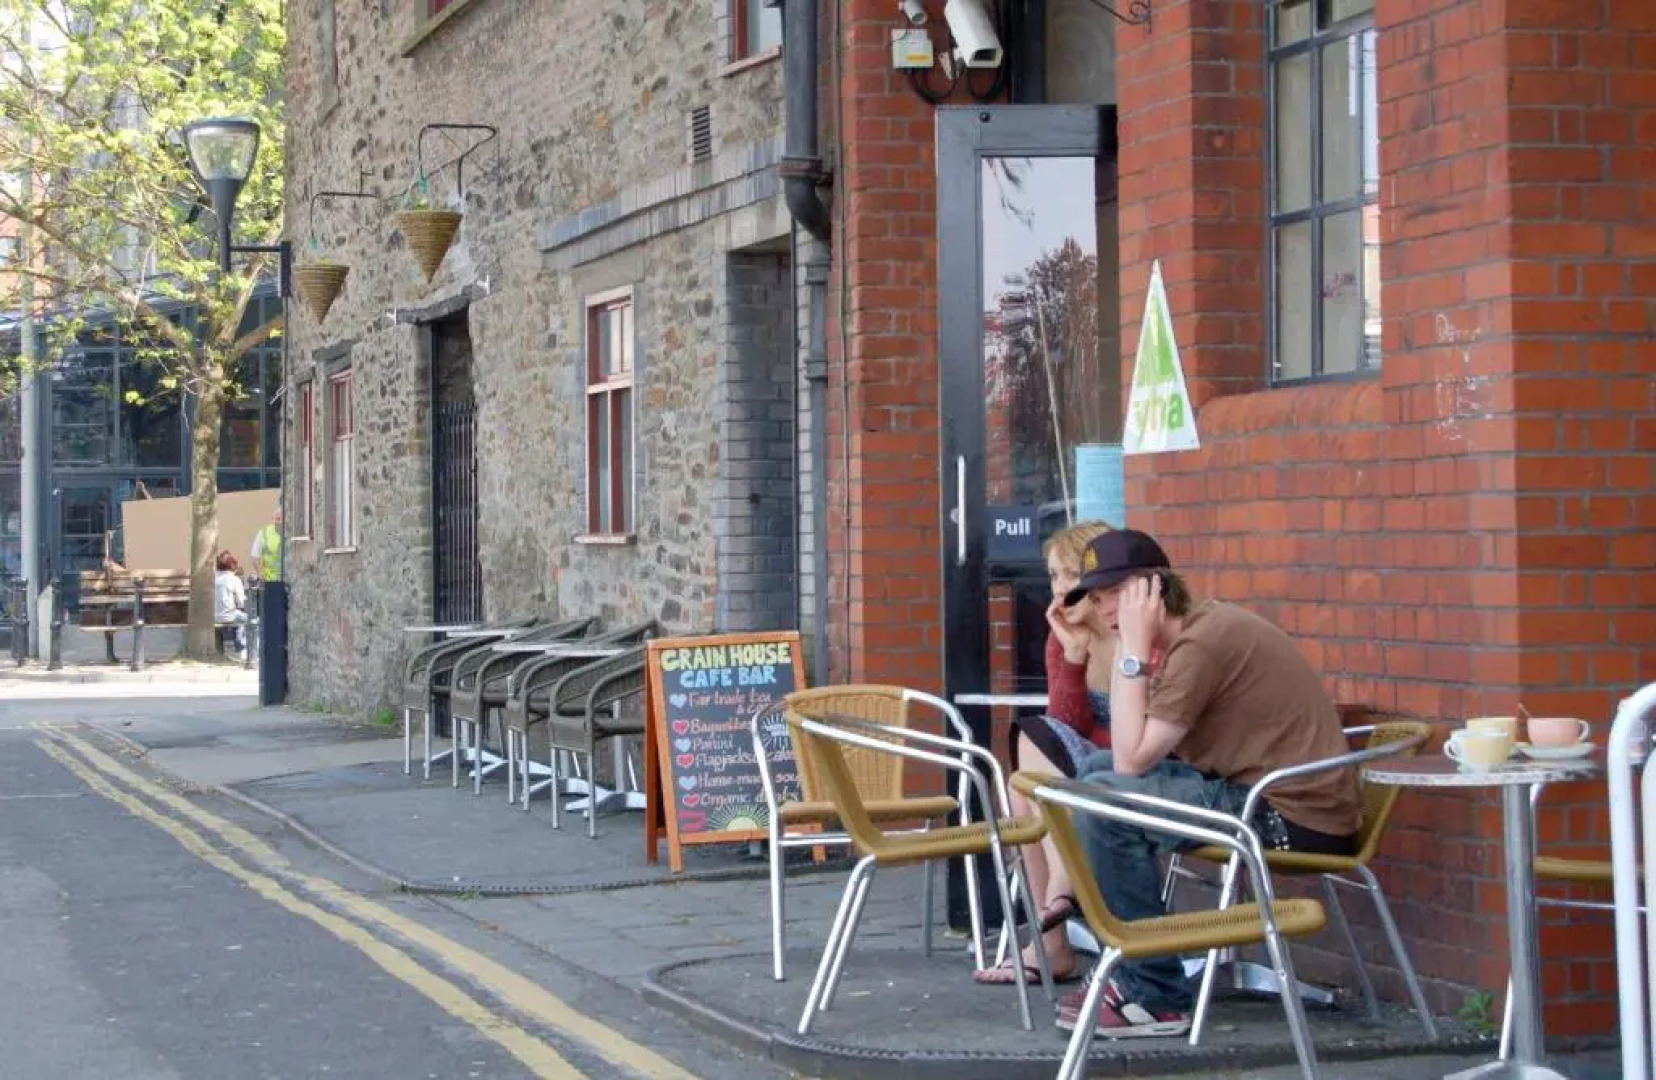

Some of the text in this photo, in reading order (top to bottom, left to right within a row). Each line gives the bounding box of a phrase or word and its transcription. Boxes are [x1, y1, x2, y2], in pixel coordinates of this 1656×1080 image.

[995, 517, 1031, 536] Pull
[660, 643, 792, 671] GRAIN HOUSE
[680, 665, 777, 688] CAFE BAR
